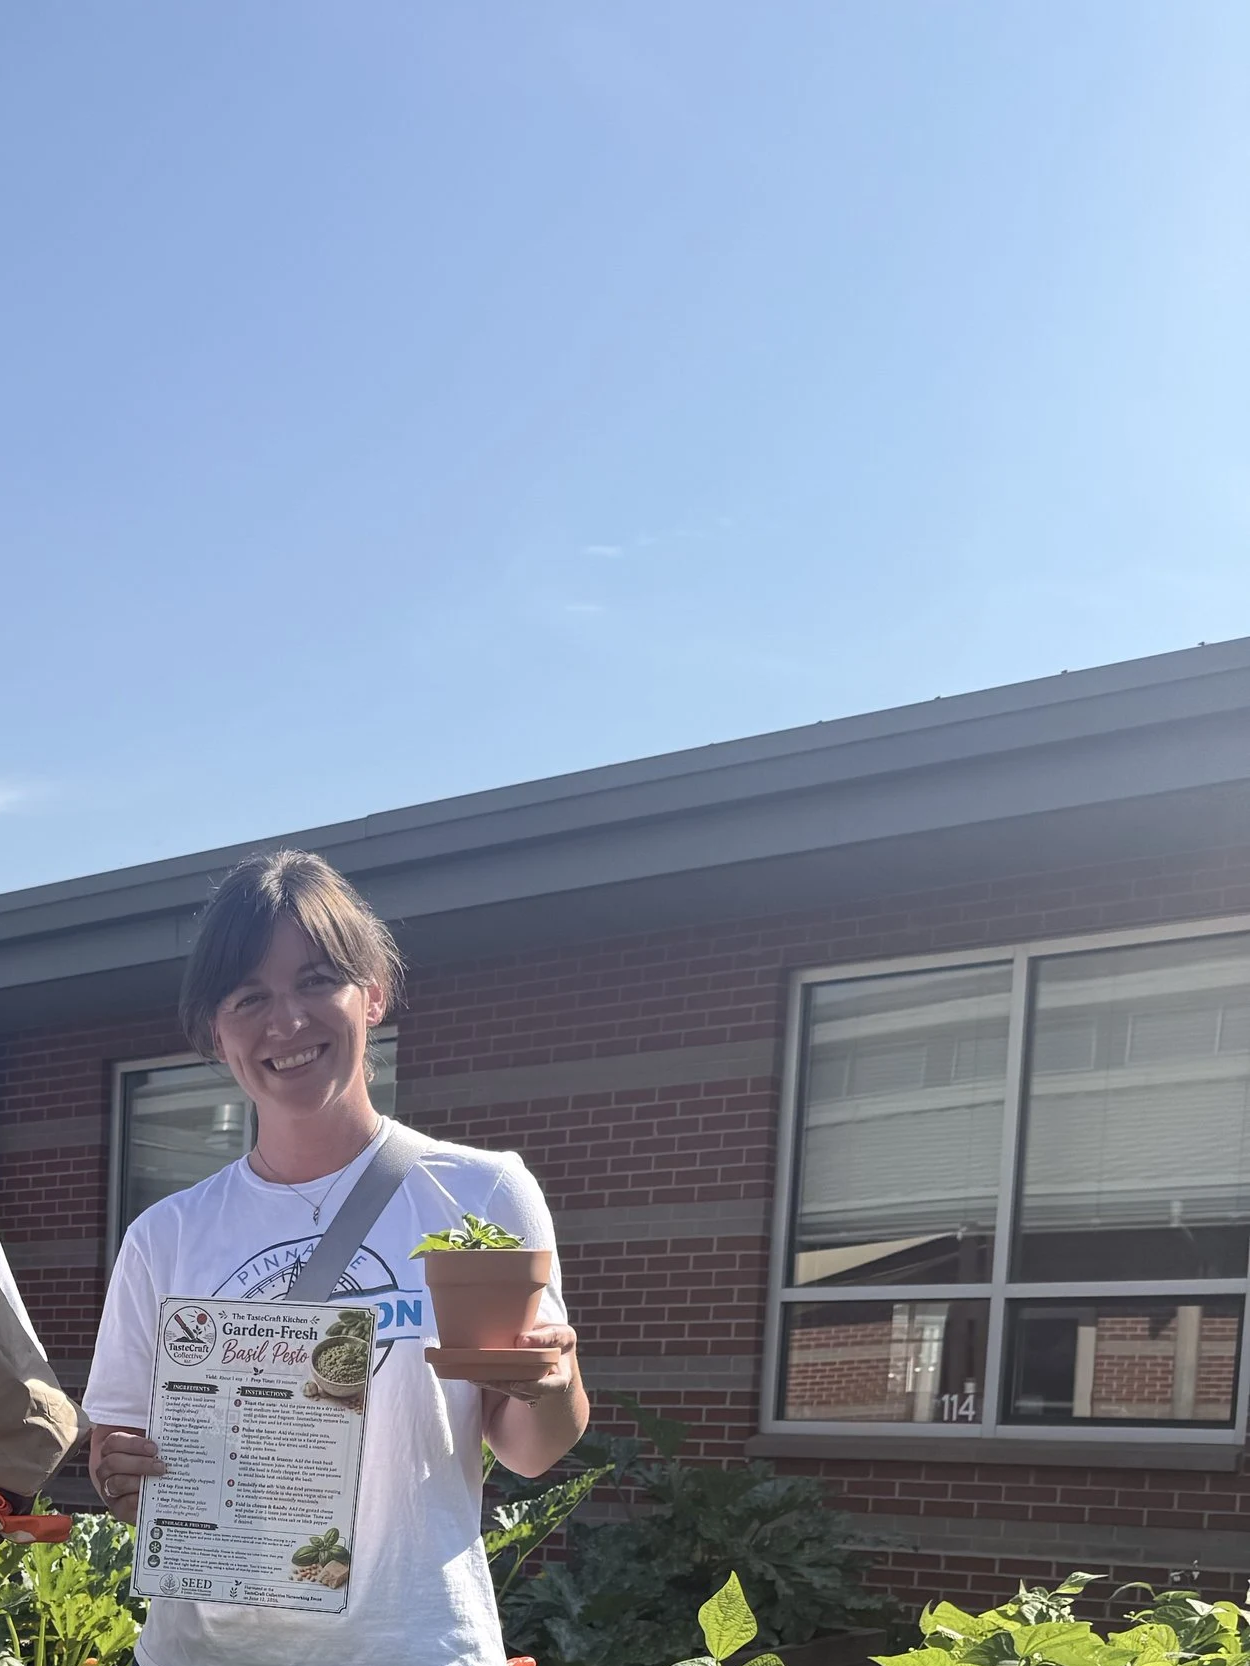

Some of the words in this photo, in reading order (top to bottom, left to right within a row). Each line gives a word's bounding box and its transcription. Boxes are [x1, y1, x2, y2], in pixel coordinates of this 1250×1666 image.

[237, 1243, 367, 1285] PINNAE
[232, 1313, 245, 1321] The
[248, 1314, 281, 1322] TasteCraft
[283, 1315, 308, 1324] Kitchen
[222, 1322, 318, 1341] Garden-Fresh
[169, 1343, 209, 1353] TasteCraft
[221, 1339, 270, 1364] Basil
[272, 1341, 309, 1366] Pesto
[173, 1352, 203, 1360] Collective
[245, 1389, 287, 1397] INSTRUCTIONS
[941, 1394, 976, 1422] 114
[182, 1578, 213, 1589] SEED
